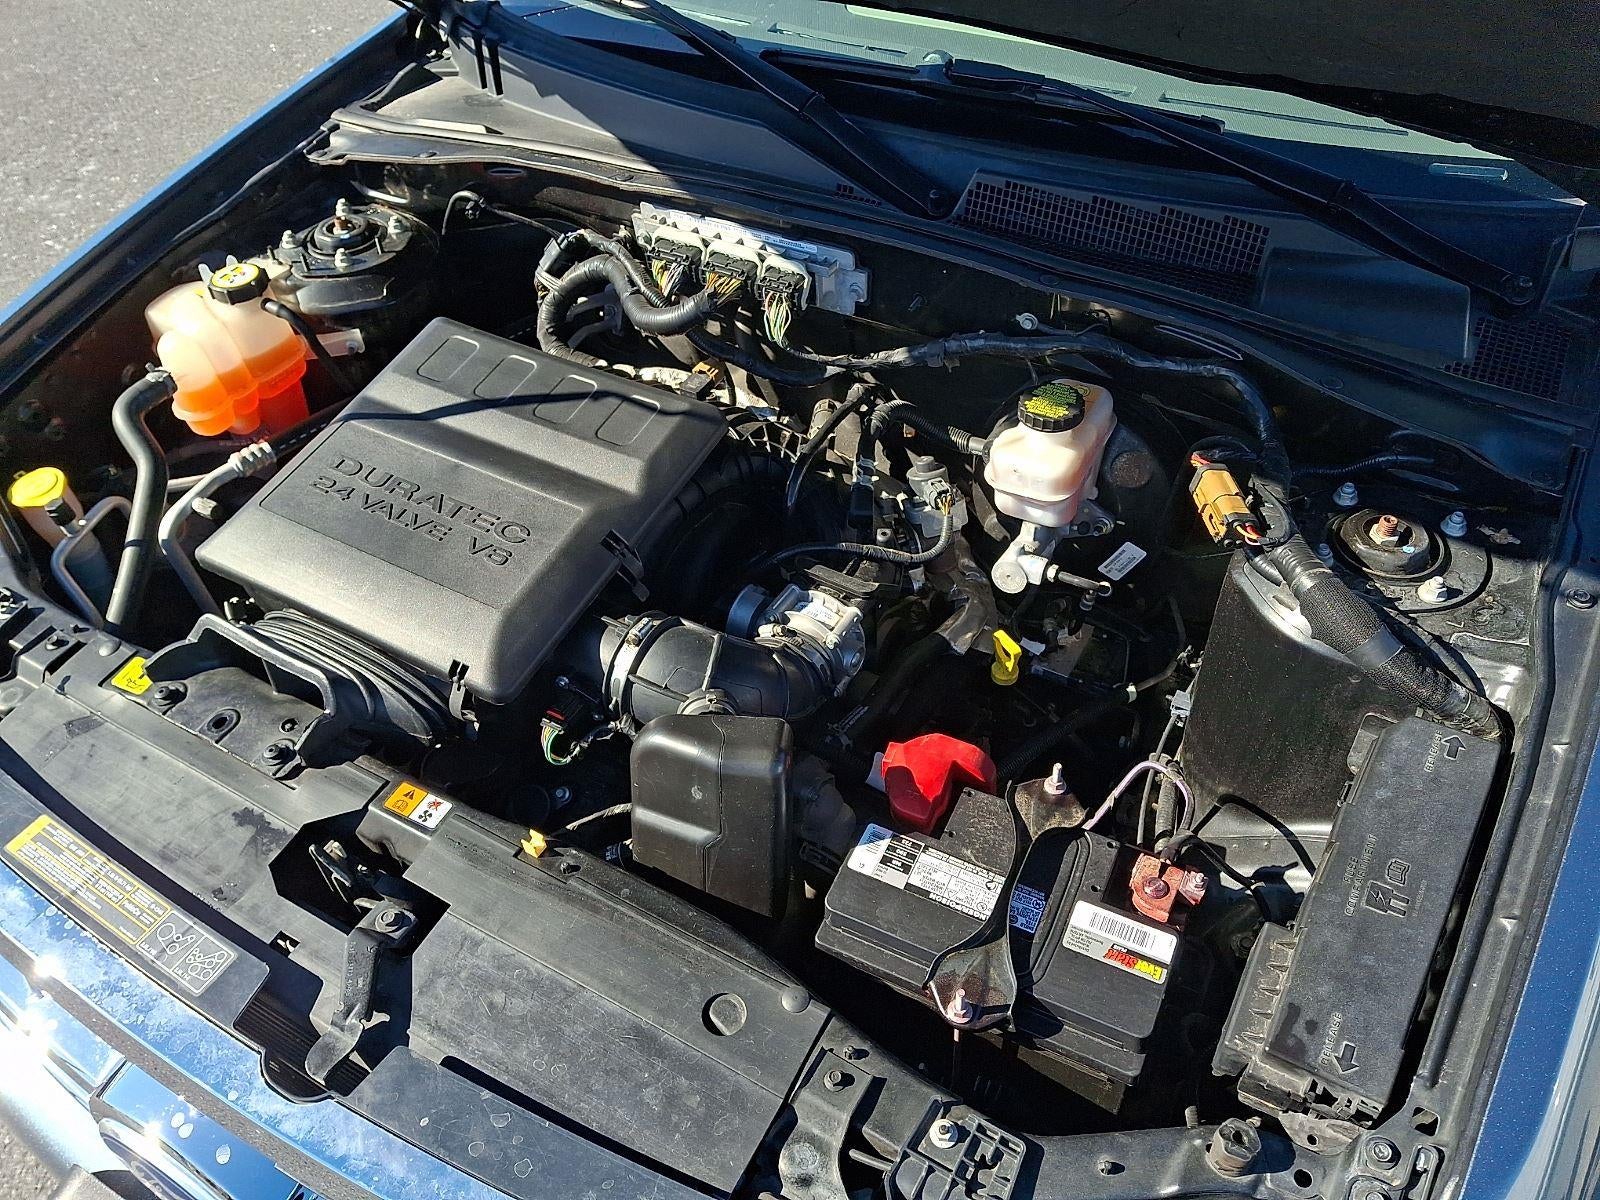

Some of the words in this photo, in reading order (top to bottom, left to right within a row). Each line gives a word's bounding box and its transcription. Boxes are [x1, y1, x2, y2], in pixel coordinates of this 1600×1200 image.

[310, 475, 355, 502] 24
[361, 493, 452, 541] VALVE
[469, 536, 513, 566] V6
[329, 455, 531, 544] DURATEC
[1424, 730, 1443, 773] RELEASE
[1343, 856, 1359, 883] FUSE
[1344, 833, 1378, 917] COMPARTMENT
[1103, 948, 1163, 981] EverStart
[1320, 1012, 1342, 1066] RELEASE
